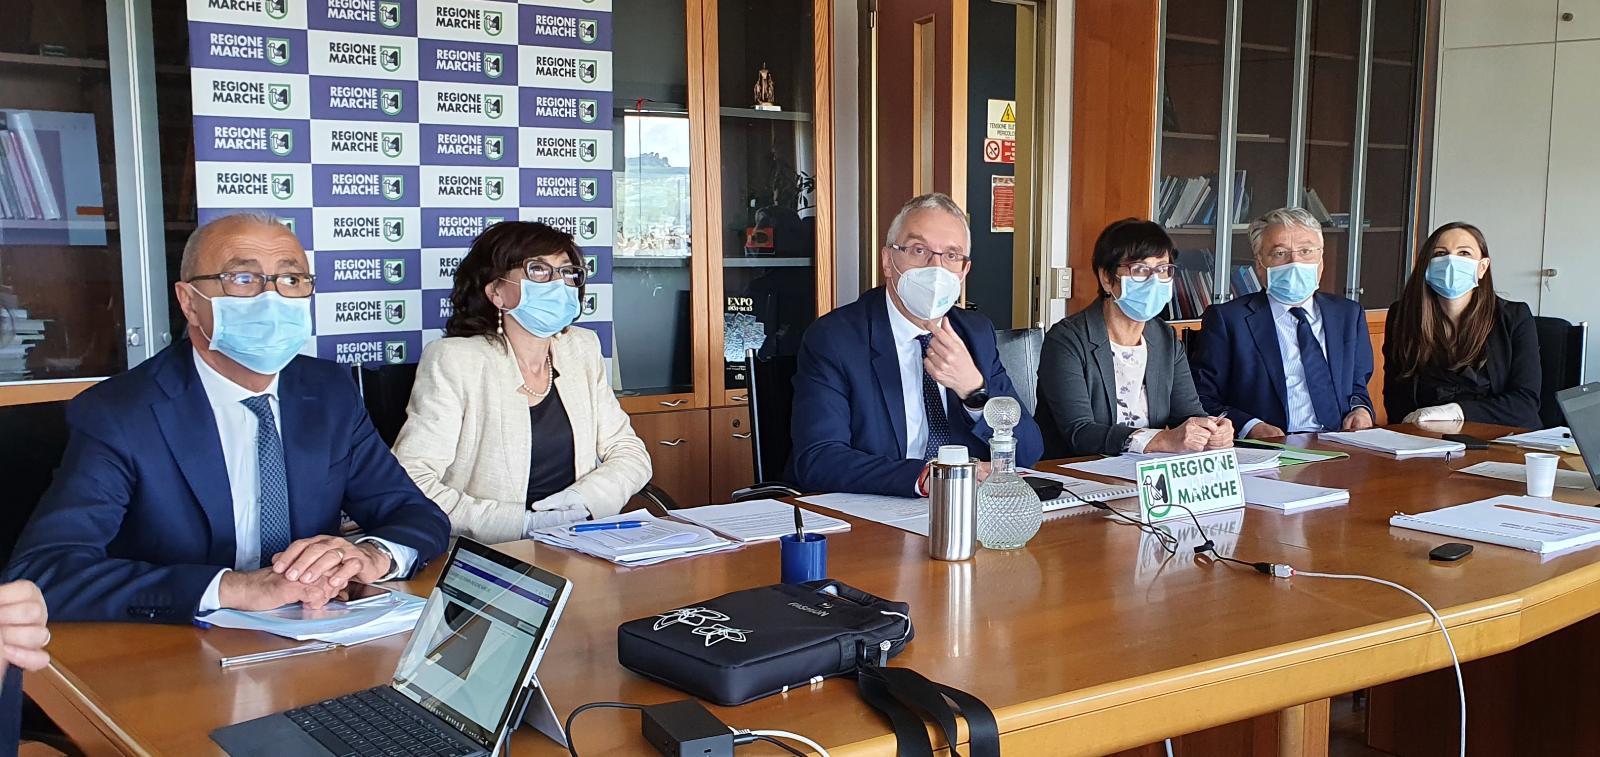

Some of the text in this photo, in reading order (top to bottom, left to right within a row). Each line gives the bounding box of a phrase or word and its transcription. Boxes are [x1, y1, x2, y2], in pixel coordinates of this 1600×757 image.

[208, 0, 262, 12] MARCHE
[328, 0, 375, 10] REGIONE
[328, 8, 376, 22] MARCHE
[436, 7, 480, 19] REGIONE
[436, 18, 480, 30] MARCHE
[536, 15, 576, 27] REGIONE
[535, 25, 577, 37] MARCHE
[210, 33, 263, 47] REGIONE
[210, 45, 264, 59] MARCHE
[329, 43, 376, 54] REGIONE
[329, 54, 377, 65] MARCHE
[437, 49, 481, 61] REGIONE
[436, 60, 481, 72] MARCHE
[536, 56, 576, 67] REGIONE
[536, 67, 576, 78] MARCHE
[213, 81, 264, 93] REGIONE
[330, 87, 377, 98] REGIONE
[213, 92, 265, 104] MARCHE
[437, 92, 481, 103] REGIONE
[536, 97, 576, 108] REGIONE
[329, 98, 378, 109] MARCHE
[437, 103, 482, 113] MARCHE
[536, 107, 577, 118] MARCHE
[214, 127, 266, 138] REGIONE
[332, 131, 378, 141] REGIONE
[214, 138, 267, 150] MARCHE
[437, 134, 482, 145] REGIONE
[536, 138, 576, 148] REGIONE
[331, 142, 378, 152] MARCHE
[437, 144, 482, 155] MARCHE
[536, 148, 577, 157] MARCHE
[217, 173, 267, 183] REGIONE
[332, 174, 379, 184] REGIONE
[438, 176, 482, 186] REGIONE
[536, 177, 577, 187] REGIONE
[217, 184, 268, 195] MARCHE
[332, 184, 379, 195] MARCHE
[438, 186, 482, 196] MARCHE
[536, 187, 577, 197] MARCHE
[333, 218, 380, 227] REGIONE
[438, 216, 483, 226] REGIONE
[537, 216, 577, 226] REGIONE
[333, 228, 380, 237] MARCHE
[438, 226, 483, 237] MARCHE
[334, 259, 380, 270] REGIONE
[334, 269, 381, 280] MARCHE
[336, 301, 381, 312] REGIONE
[728, 296, 753, 306] EXPO
[335, 311, 382, 322] MARCHE
[336, 342, 382, 354] REGIONE
[336, 352, 383, 363] MARCHE
[1171, 455, 1234, 478] REGIONE
[1178, 480, 1238, 504] MARCHE
